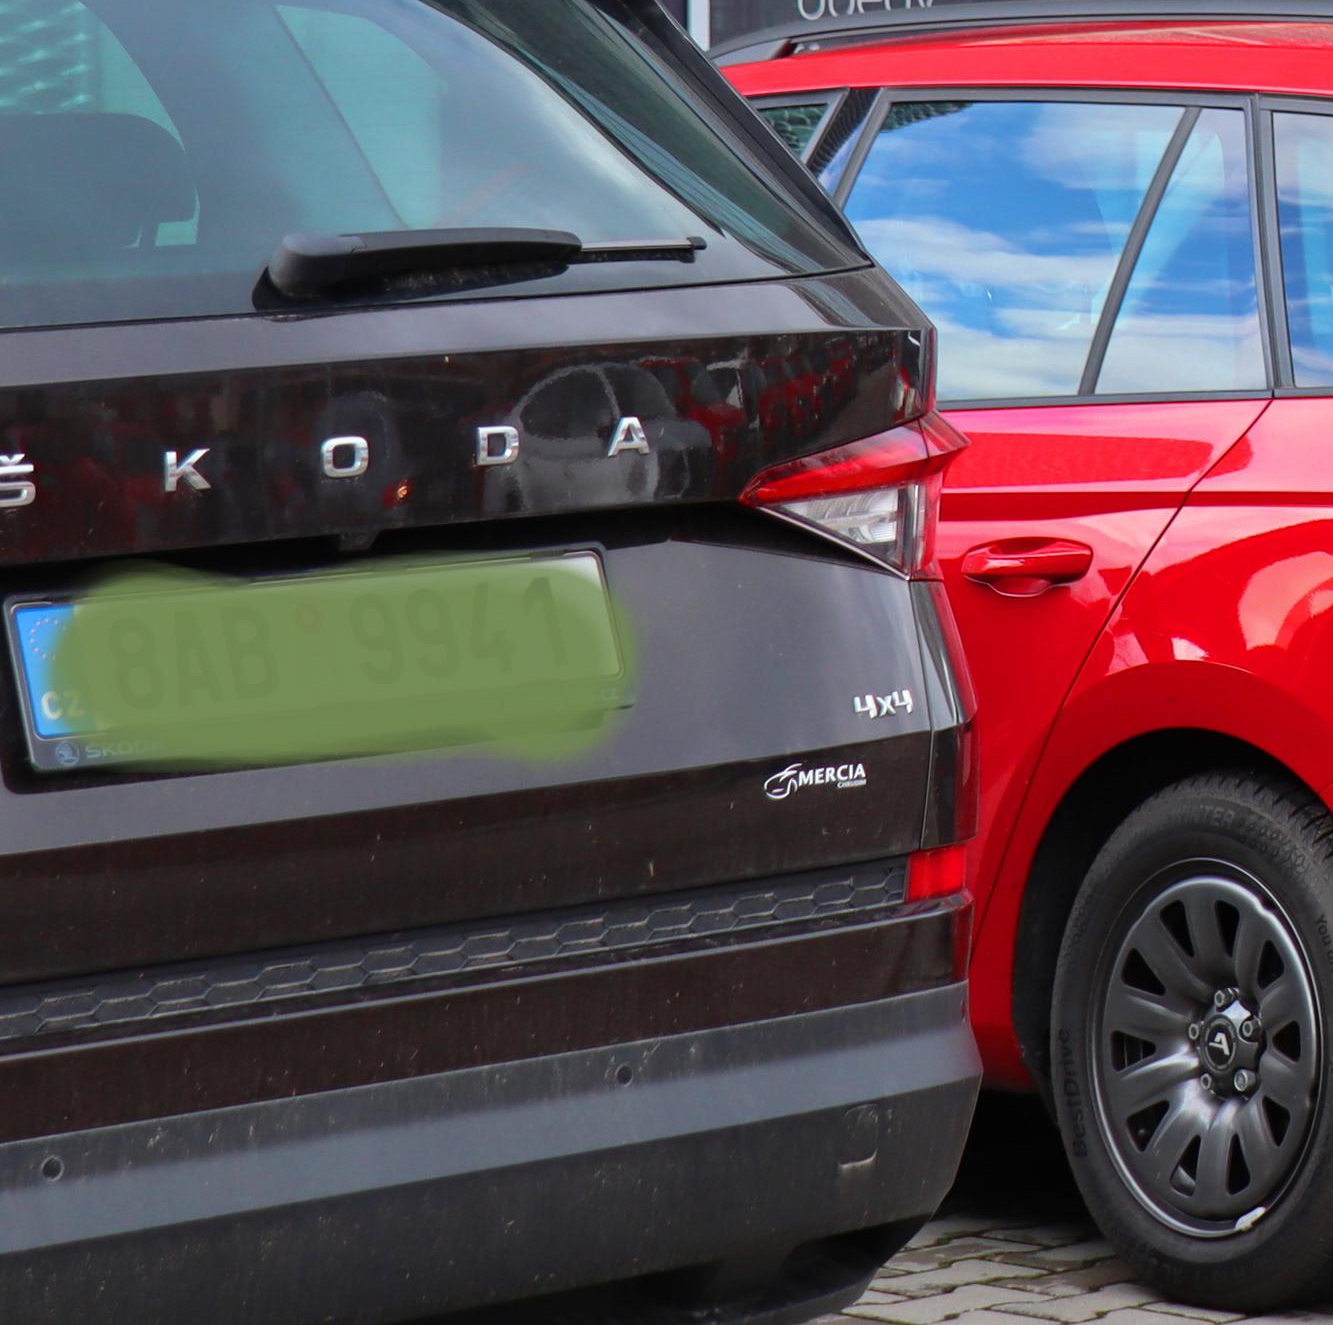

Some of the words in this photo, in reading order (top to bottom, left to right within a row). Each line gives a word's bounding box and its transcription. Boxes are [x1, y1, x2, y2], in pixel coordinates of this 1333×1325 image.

[0, 415, 652, 508] ŠKODA
[853, 689, 914, 719] 4x4
[798, 762, 867, 787] MERCIA
